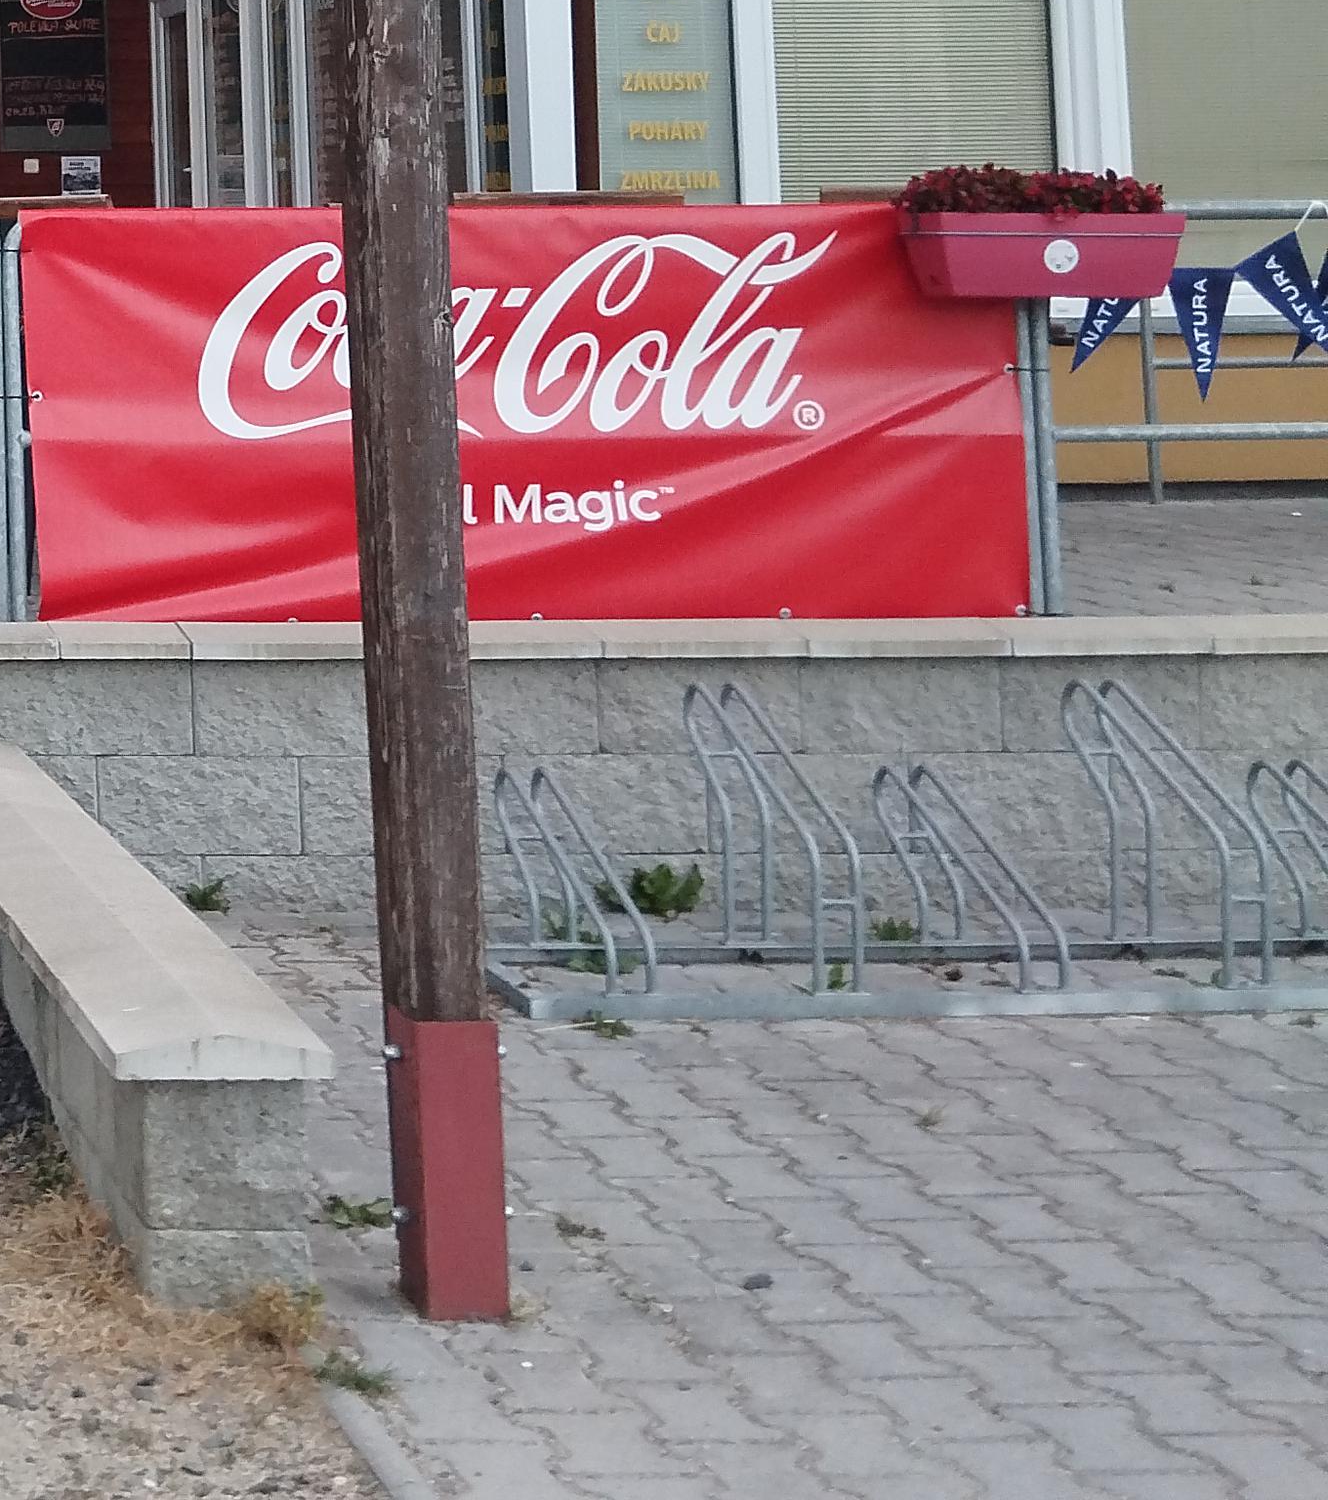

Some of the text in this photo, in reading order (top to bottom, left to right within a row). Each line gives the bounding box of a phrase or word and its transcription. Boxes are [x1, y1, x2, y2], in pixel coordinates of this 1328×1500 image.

[620, 169, 720, 192] ZMRZLINA
[197, 230, 838, 441] Coa-Cola
[1193, 277, 1212, 373] NATURA
[1265, 254, 1328, 342] NATURA
[494, 480, 661, 533] Magic
